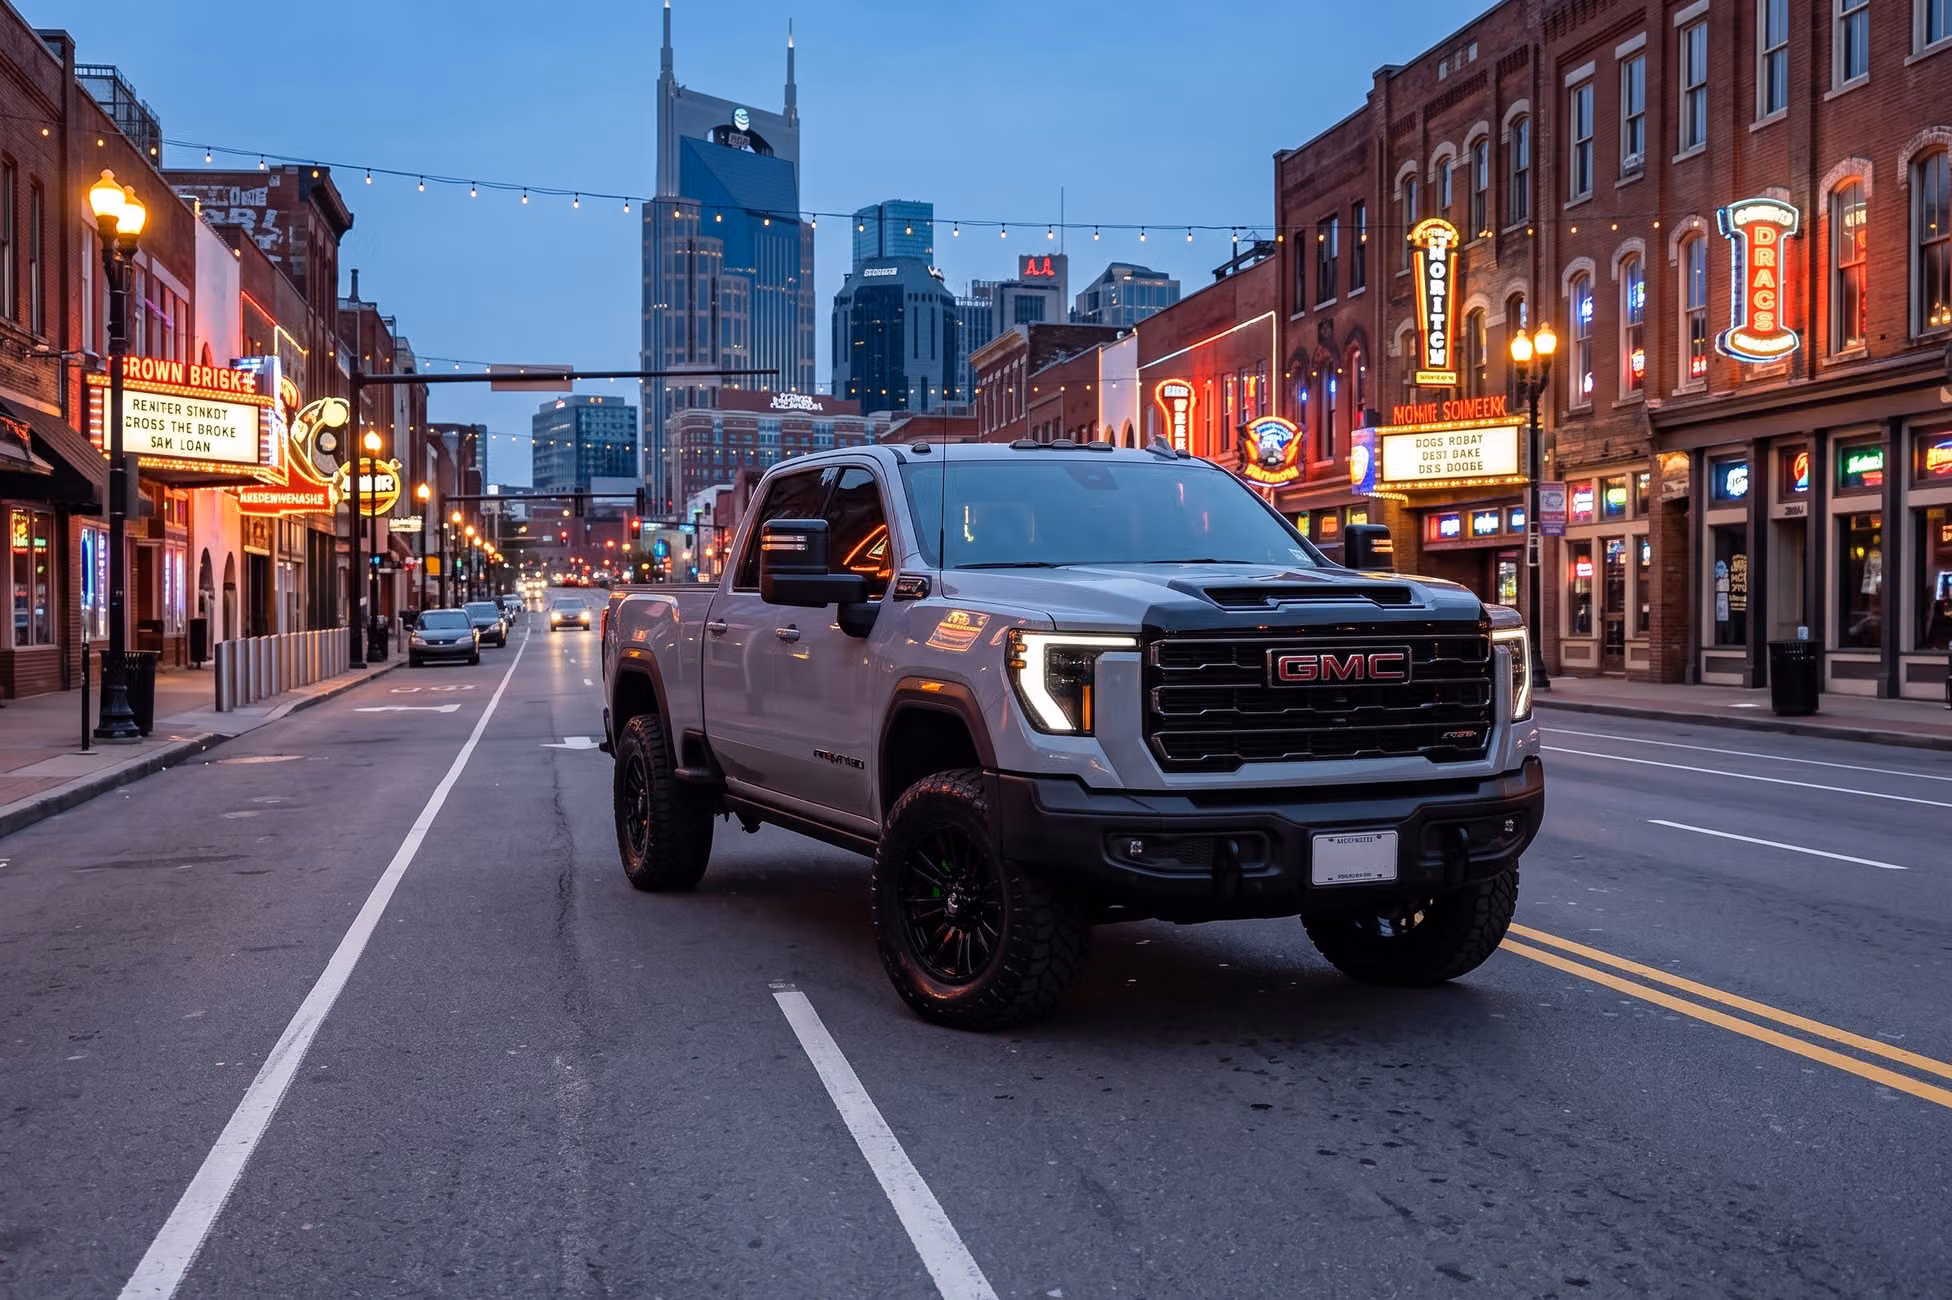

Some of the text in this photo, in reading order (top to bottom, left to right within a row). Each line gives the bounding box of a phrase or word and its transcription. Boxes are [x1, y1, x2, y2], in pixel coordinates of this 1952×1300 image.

[1753, 226, 1776, 332] DRACS
[171, 421, 193, 434] THE
[198, 423, 236, 438] BROKE
[180, 439, 211, 453] LOAN
[1416, 438, 1444, 448] DOGS
[1278, 653, 1405, 681] GMC
